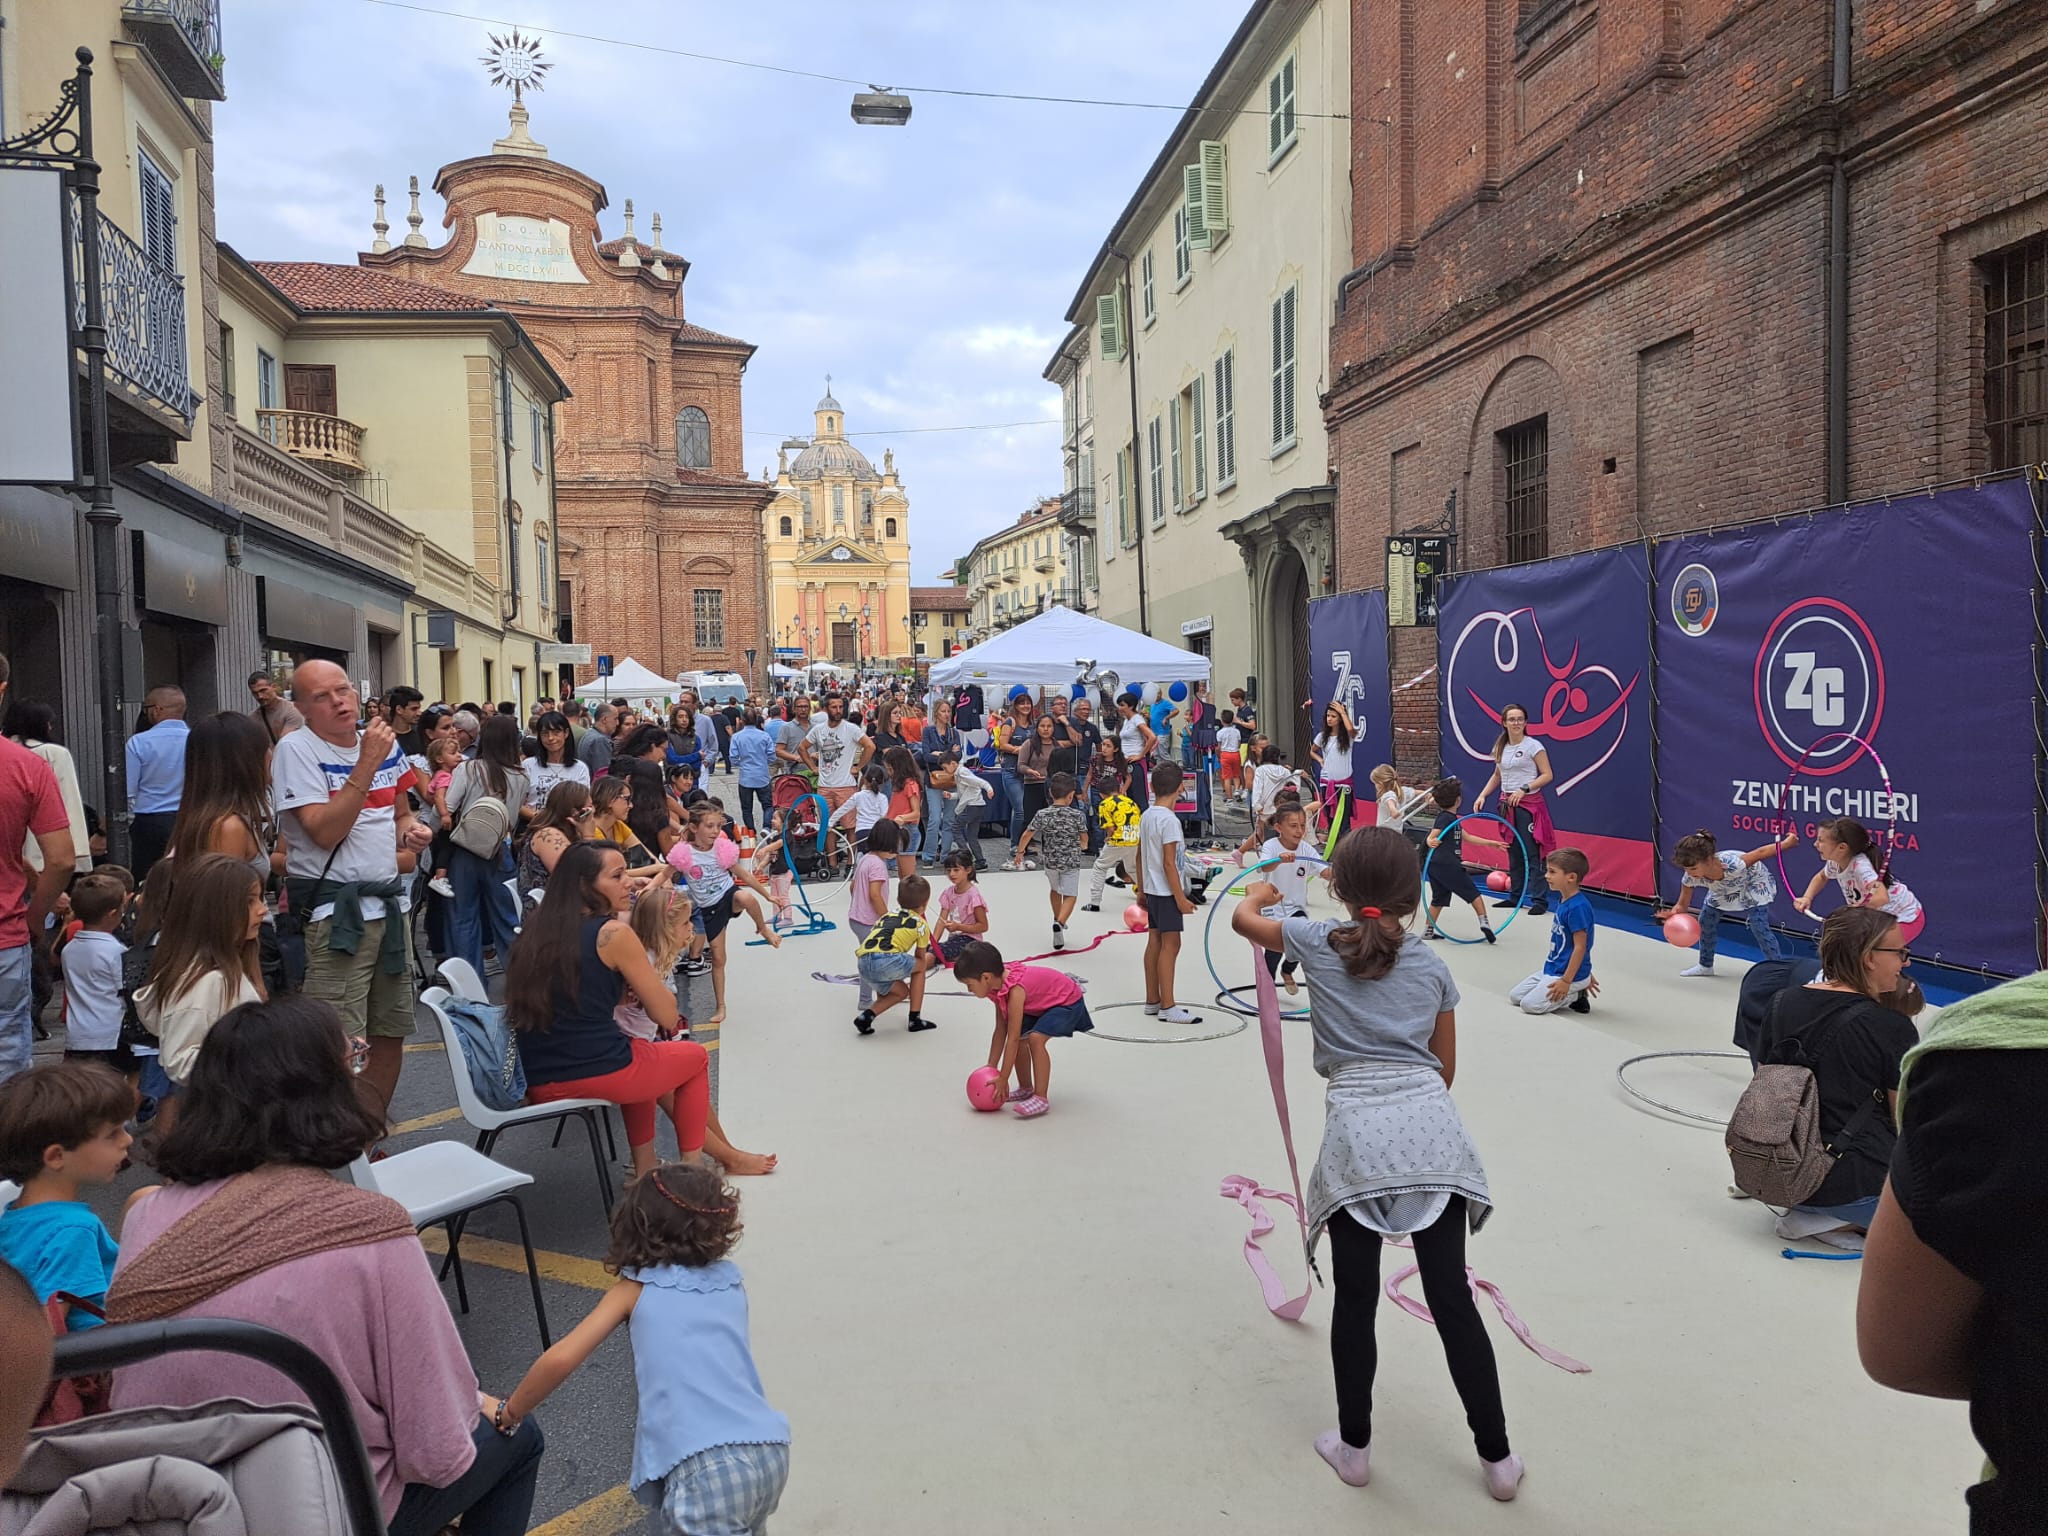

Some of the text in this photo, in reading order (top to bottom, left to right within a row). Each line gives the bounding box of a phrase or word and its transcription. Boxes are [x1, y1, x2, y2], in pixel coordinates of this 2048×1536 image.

[1402, 545, 1413, 553] 30
[1421, 540, 1440, 548] GTT
[1784, 651, 1845, 727] ZC
[1731, 779, 1919, 823] ZENITH CHIERI
[1732, 814, 1799, 836] SOCIETÀ
